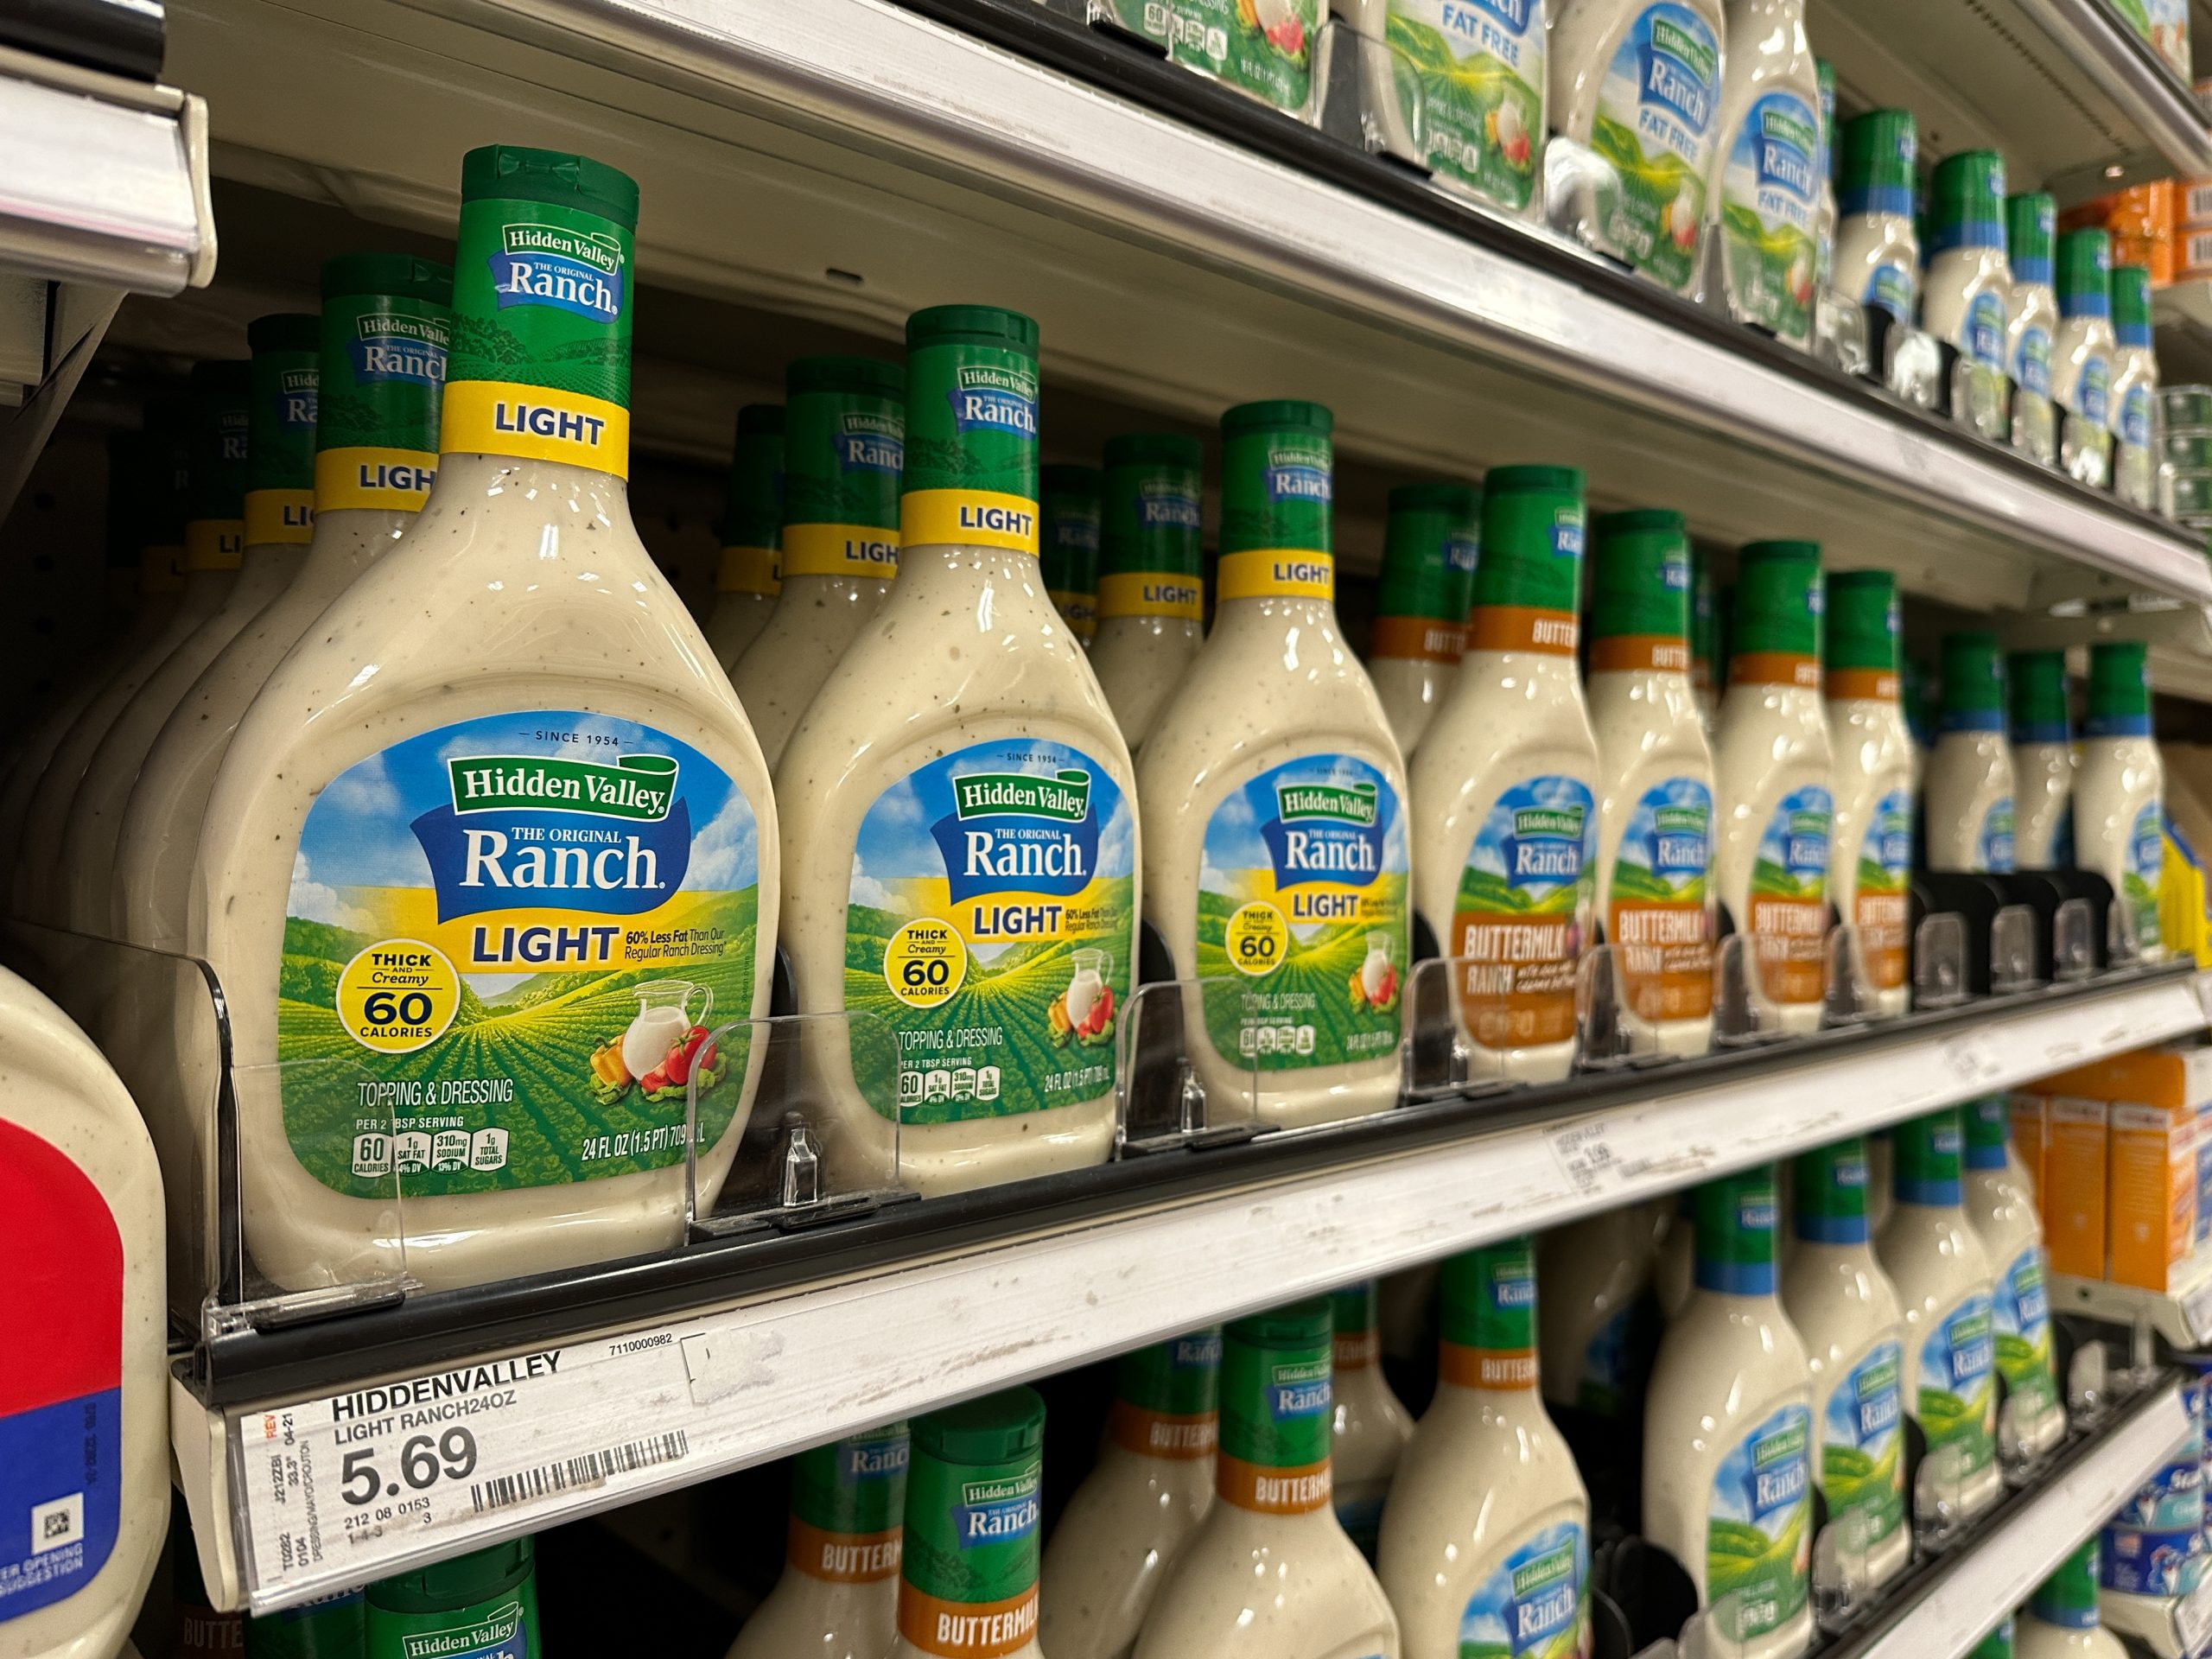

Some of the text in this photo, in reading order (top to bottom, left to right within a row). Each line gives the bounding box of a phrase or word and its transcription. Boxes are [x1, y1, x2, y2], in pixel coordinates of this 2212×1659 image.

[1442, 4, 1478, 38] FAT
[1481, 24, 1518, 67] FREE
[1649, 58, 1704, 125] Ranch
[510, 230, 615, 270] Hidden Valley
[534, 262, 594, 283] THE ORIGINAL
[508, 262, 612, 313] Ranch
[363, 318, 449, 345] Hidden Valle
[964, 370, 1009, 387] Hidden
[495, 403, 605, 446] LIGHT
[964, 396, 1033, 433] Ranch
[359, 465, 437, 491] LIGH
[1275, 473, 1330, 499] Ranch
[960, 506, 1033, 536] LIGHT
[845, 541, 899, 564] LIGH
[1274, 563, 1329, 585] LIGHT
[1143, 585, 1198, 604] LIGHT
[536, 730, 619, 747] SINCE 1954
[1007, 753, 1057, 764] SINCE 1954
[462, 767, 665, 815] Hidden Valley
[963, 782, 1084, 817] Hidden Valley
[1285, 790, 1373, 819] Hidden Valley
[512, 827, 622, 844] THE ORIGINAL
[995, 828, 1062, 841] THE ORIGINAL
[459, 829, 658, 890] Ranch
[963, 830, 1083, 877] Ranch
[1285, 830, 1372, 872] Ranch
[1516, 842, 1578, 876] Ranch
[1243, 911, 1273, 920] THICK
[1294, 893, 1358, 917] LIGHT
[974, 906, 1062, 935] LIGHT
[1243, 922, 1273, 932] Creamy
[473, 926, 620, 963] LIGHT
[626, 927, 725, 944] 60% Less Fat Than Our
[907, 930, 948, 940] THICK
[1240, 936, 1275, 957] 60
[1464, 923, 1565, 960] BUTTERMILK
[372, 953, 432, 966] THICK
[625, 944, 662, 962] Regular
[663, 944, 690, 957] Ranch
[907, 944, 946, 956] Creamy
[1237, 957, 1275, 966] CALORIES
[372, 971, 429, 987] Creamy
[903, 959, 950, 987] 60
[900, 986, 950, 996] CALORIES
[1280, 993, 1316, 1010] DRESSING
[364, 991, 433, 1026] 60
[360, 1027, 432, 1038] CALORIES
[899, 1026, 1002, 1051] TOPPING & DRESSING
[922, 1058, 940, 1068] TBSP
[942, 1056, 972, 1067] SERVING
[357, 1078, 514, 1107] TOPPING & DRESSING
[901, 1075, 918, 1094] 60
[356, 1118, 378, 1130] PER
[380, 1119, 387, 1130] 2
[418, 1116, 464, 1128] SERVING
[360, 1137, 385, 1161] 60
[406, 1136, 418, 1150] 1g
[436, 1135, 467, 1147] 310mg
[480, 1146, 499, 1155] TOTAL
[486, 1133, 495, 1146] 1g
[582, 1123, 687, 1160] 24 FL OZ (1.5 PT) 709
[397, 1149, 425, 1160] SAT FAT
[436, 1147, 466, 1158] SODIUM
[475, 1155, 503, 1166] SUGARS
[353, 1163, 389, 1173] CALORIES
[609, 1333, 672, 1357] 7110000982
[332, 1351, 561, 1422] HIDDENVALLEY
[264, 1414, 277, 1439] REV
[334, 1389, 518, 1445] LIGHT RANCH24OZ
[283, 1413, 296, 1446] 04-21
[340, 1426, 478, 1505] 5.69
[969, 1483, 1014, 1501] Hidden
[344, 1497, 430, 1529] 212 08 0153
[423, 1512, 432, 1523] 3
[968, 1499, 1037, 1537] Ranch
[1517, 1583, 1574, 1639] Ranch
[410, 1622, 514, 1657] Hidden Valley
